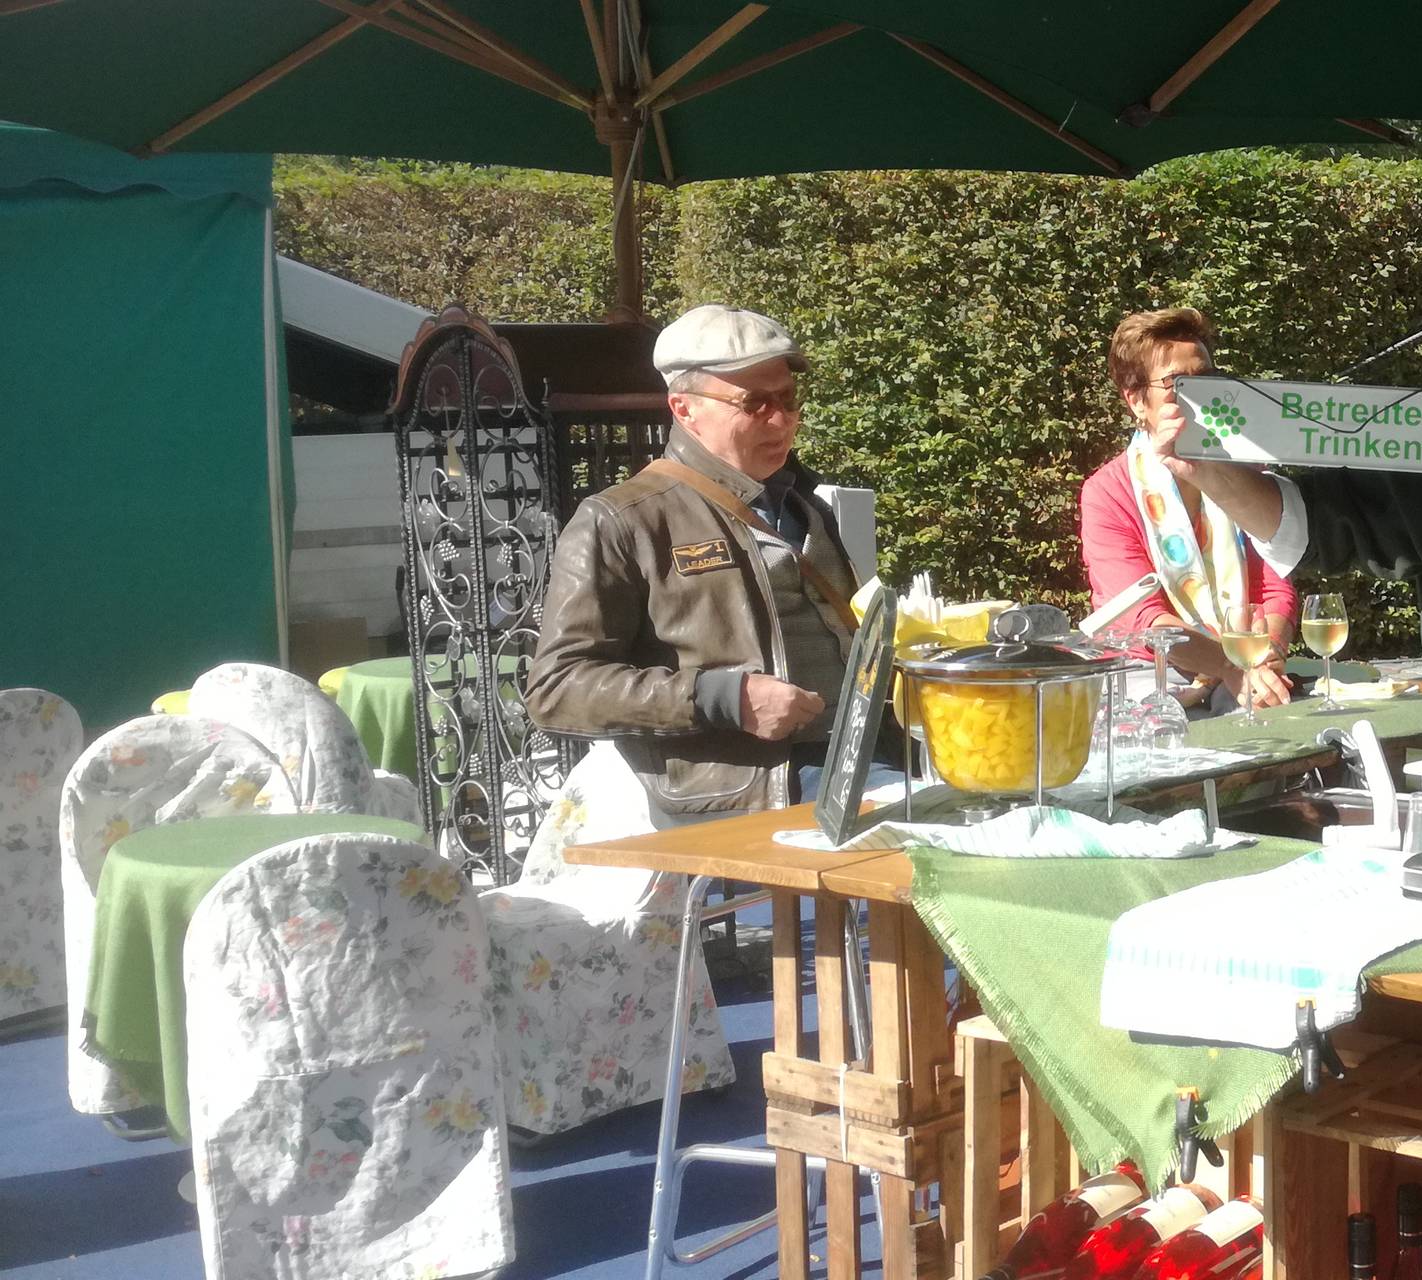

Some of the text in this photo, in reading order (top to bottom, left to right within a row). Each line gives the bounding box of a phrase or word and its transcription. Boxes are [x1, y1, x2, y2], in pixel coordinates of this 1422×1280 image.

[1300, 427, 1422, 461] Trinken
[714, 542, 725, 553] 1
[686, 556, 723, 569] LEADER
